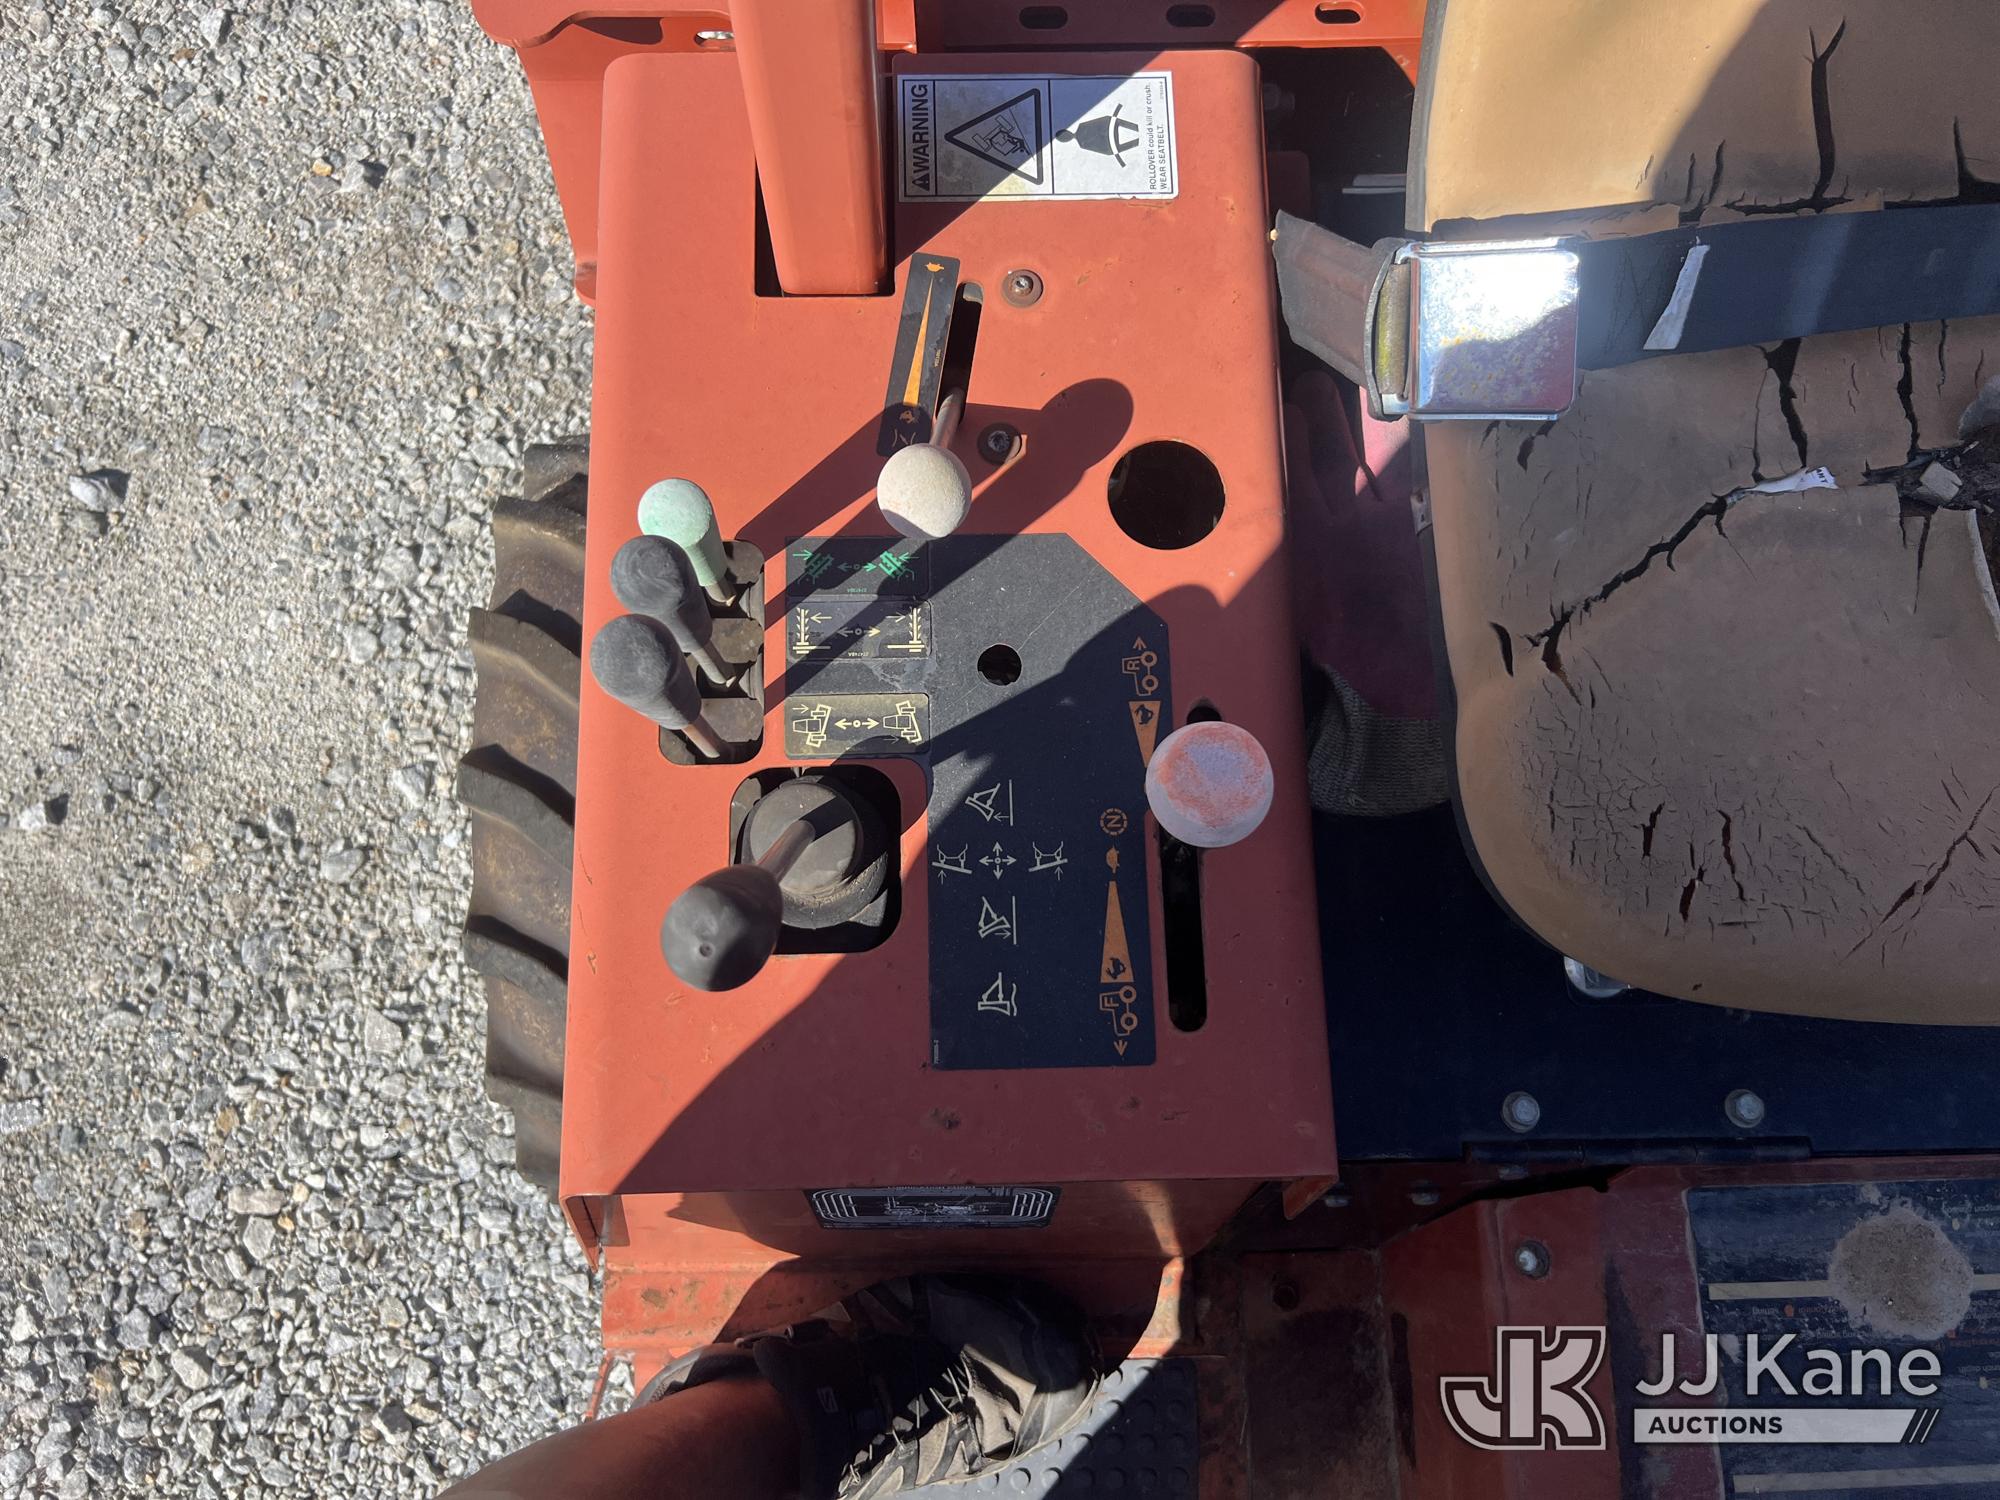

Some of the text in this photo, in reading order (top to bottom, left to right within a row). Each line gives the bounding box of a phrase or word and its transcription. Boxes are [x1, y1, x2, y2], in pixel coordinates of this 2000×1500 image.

[911, 84, 930, 174] WARNING
[1147, 128, 1155, 148] could
[1156, 124, 1167, 190] WEAR SEATBELT.
[1147, 149, 1157, 190] ROLLOVER
[1126, 660, 1140, 671] R
[1106, 815, 1121, 828] N
[1104, 996, 1119, 1007] F
